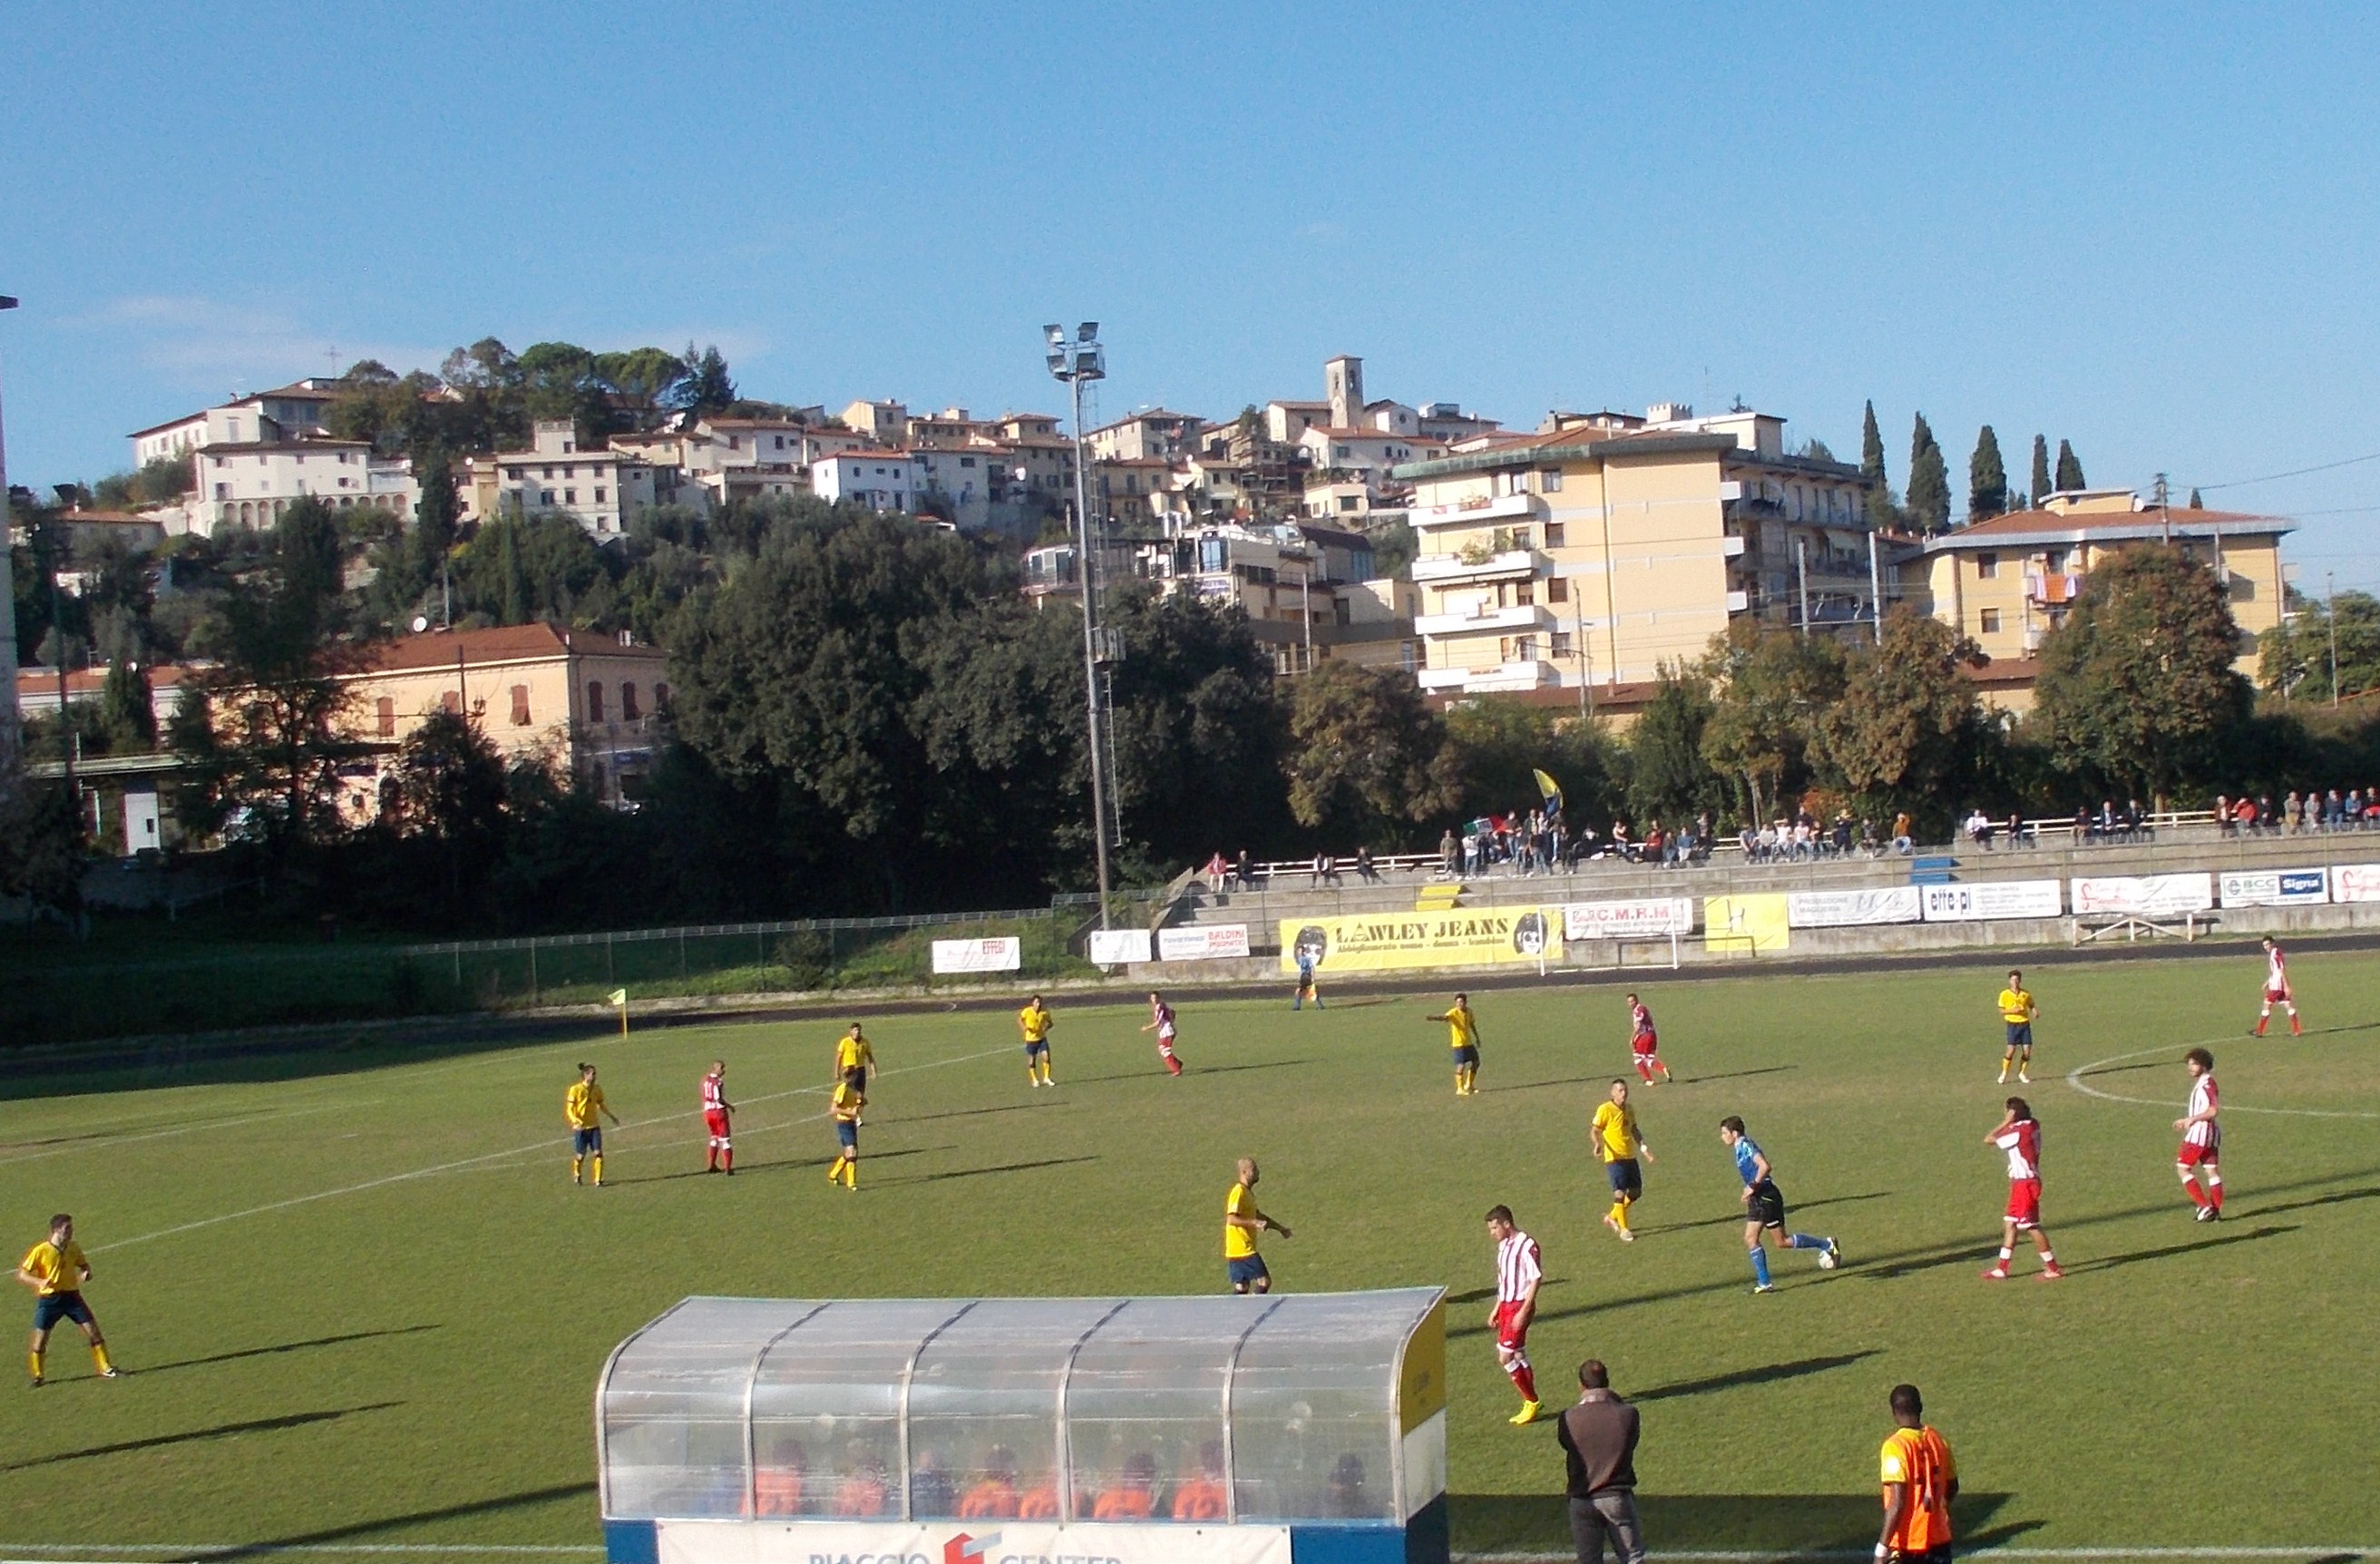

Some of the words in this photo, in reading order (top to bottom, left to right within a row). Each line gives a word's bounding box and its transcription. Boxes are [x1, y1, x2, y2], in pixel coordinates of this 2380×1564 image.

[1930, 887, 1972, 915] effe-pi
[1335, 922, 1429, 943] LAWLEY
[1434, 918, 1509, 938] JEANS
